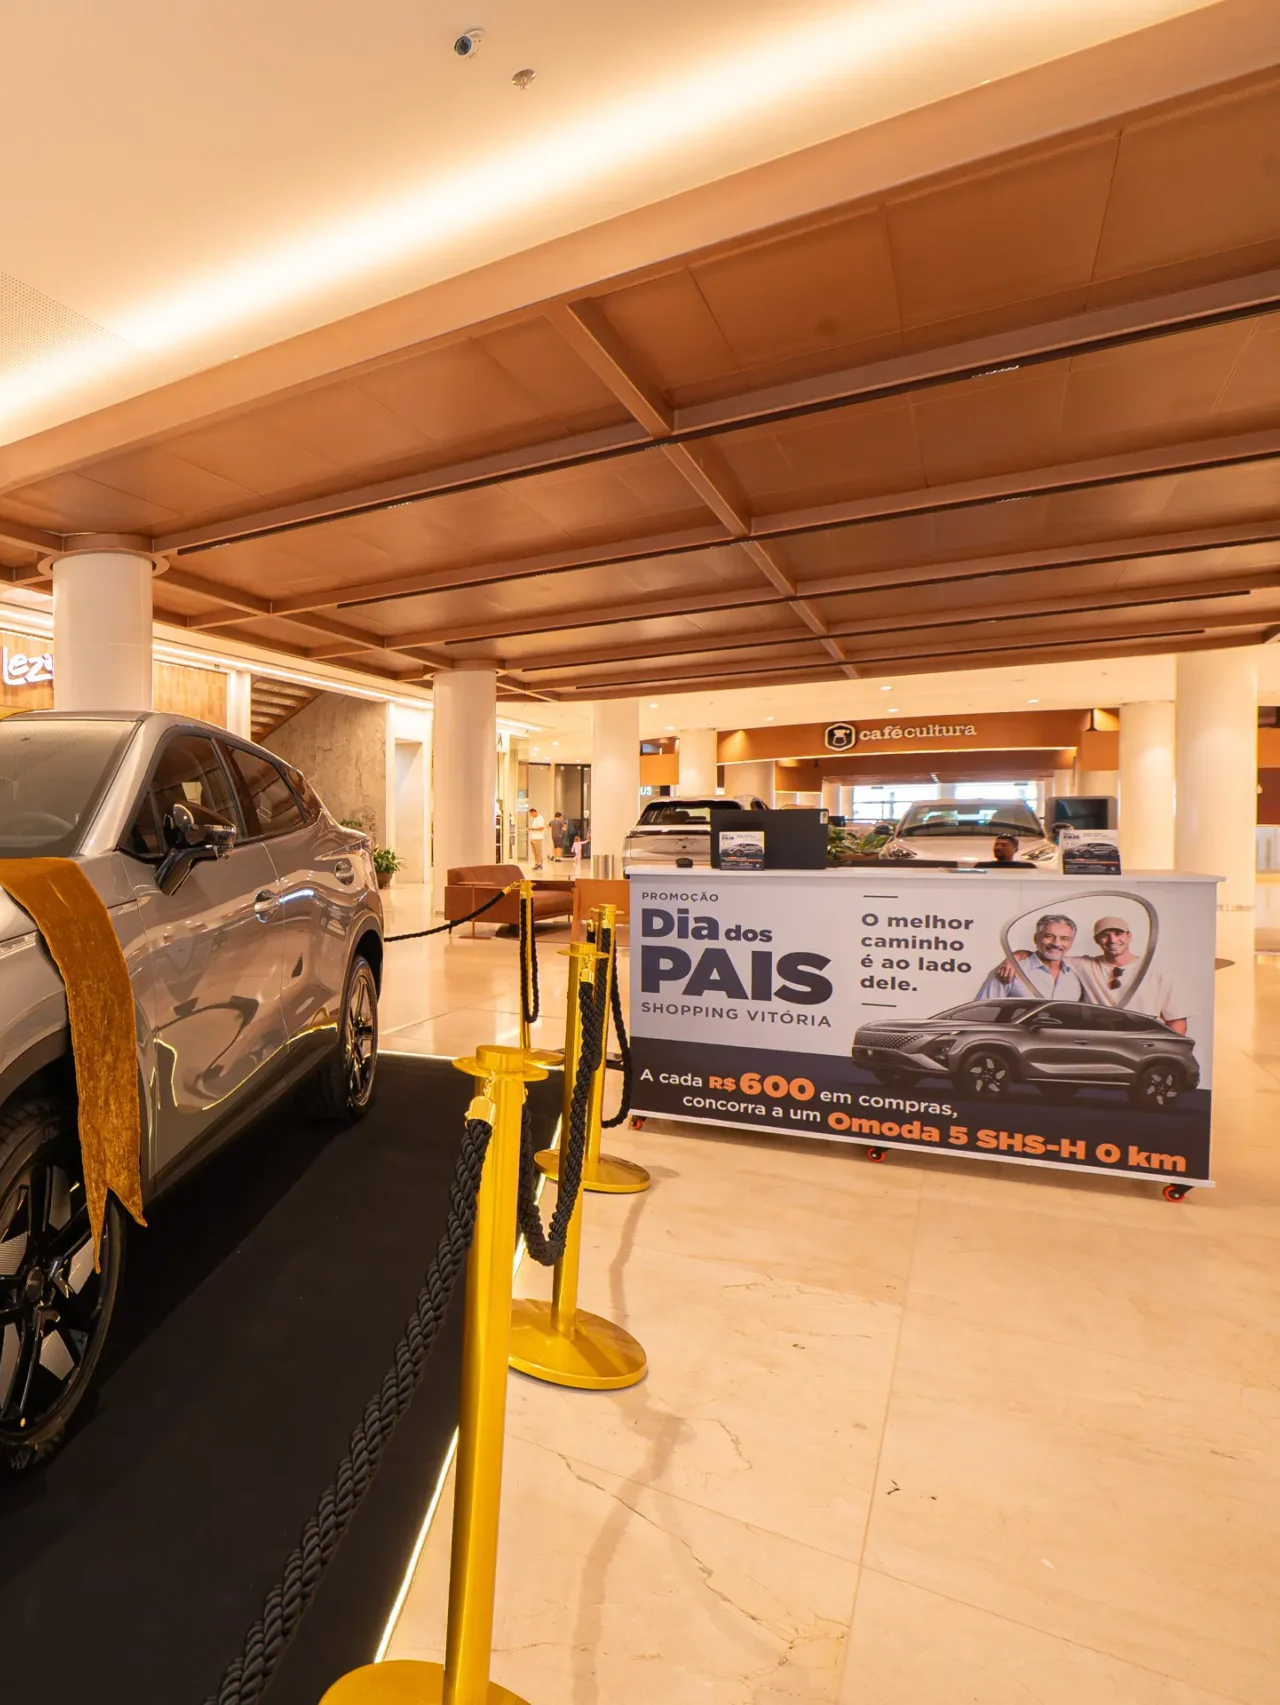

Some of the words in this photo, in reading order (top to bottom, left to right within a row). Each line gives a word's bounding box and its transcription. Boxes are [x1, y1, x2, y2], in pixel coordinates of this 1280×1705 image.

[639, 786, 652, 796] US
[641, 891, 719, 903] PROMOÇÃO
[641, 907, 720, 941] Dia
[724, 924, 773, 943] dos
[861, 913, 879, 927] O
[887, 914, 974, 930] melhor
[860, 935, 965, 951] caminho
[860, 954, 874, 968] é
[881, 957, 910, 970] ao
[918, 957, 972, 973] lado
[641, 944, 833, 1006] PAIS
[860, 975, 918, 992] dele.
[641, 1001, 739, 1020] SHOPPING
[747, 1008, 832, 1028] VITÓRIA
[640, 1068, 654, 1082] A
[659, 1072, 702, 1087] cada
[820, 1090, 852, 1104] em
[858, 1092, 959, 1119] compras,
[682, 1094, 766, 1116] concorra
[772, 1105, 784, 1118] a
[789, 1109, 821, 1122] um
[827, 1111, 940, 1142] Omoda
[948, 1126, 968, 1145] 5
[975, 1128, 1086, 1160] SHS-H
[1128, 1146, 1187, 1173] km
